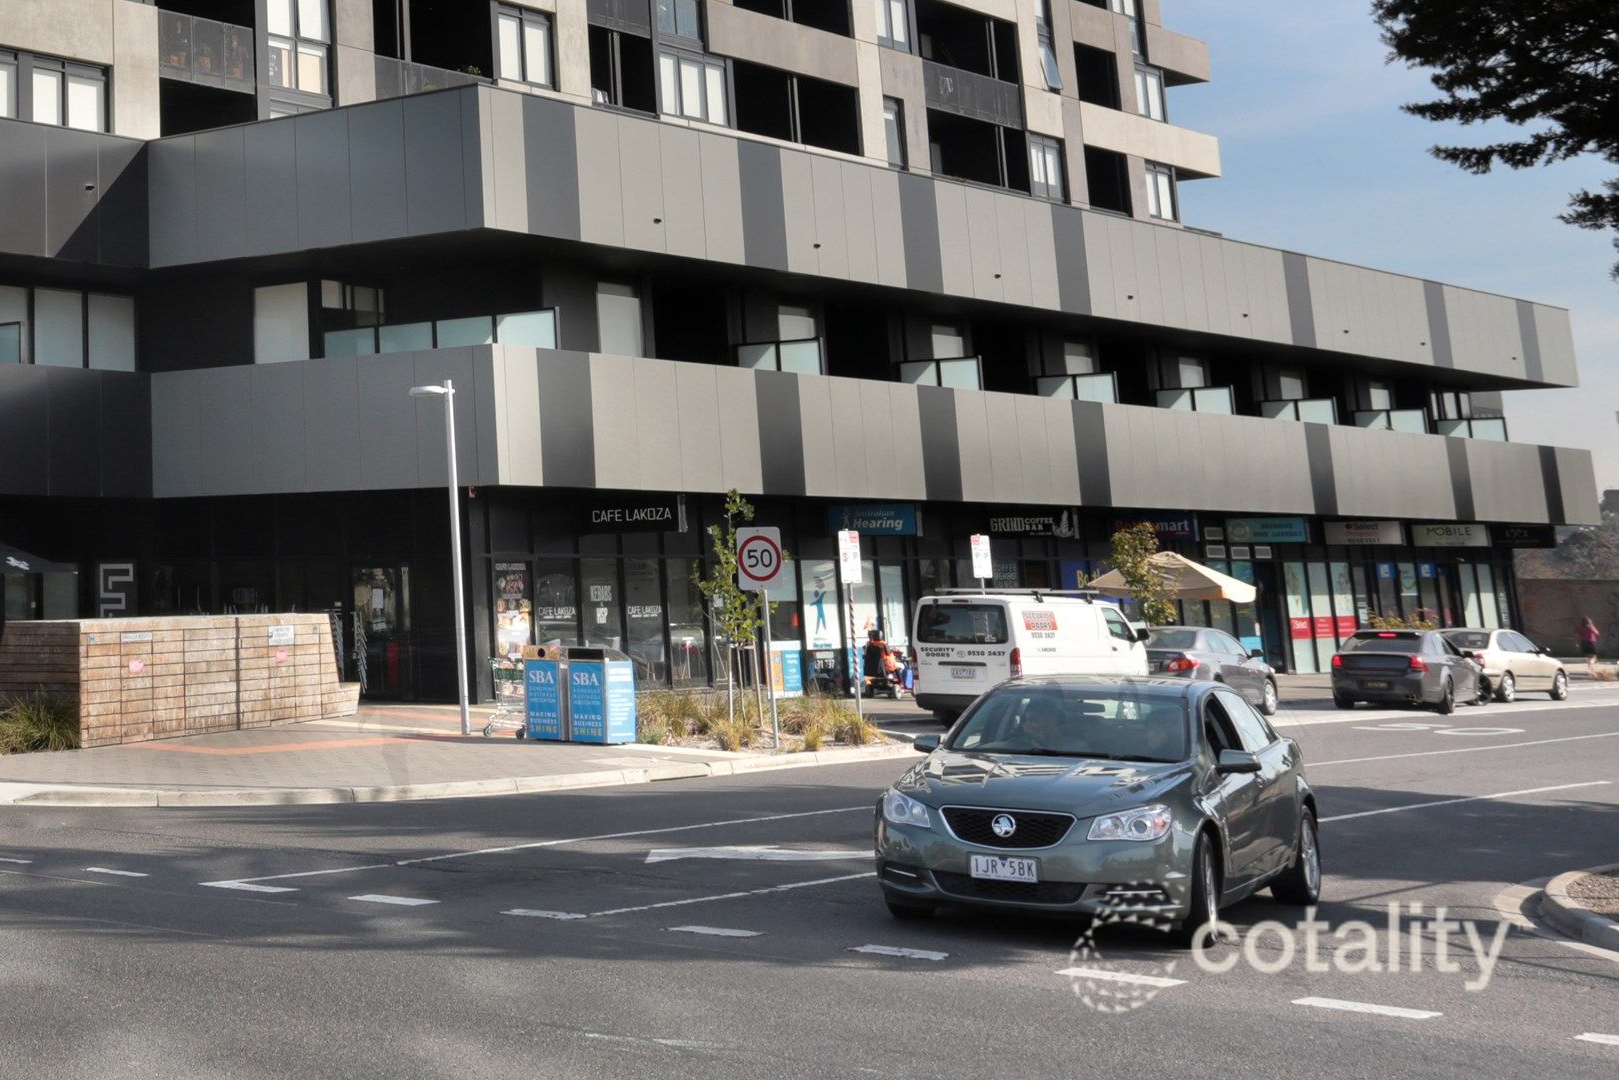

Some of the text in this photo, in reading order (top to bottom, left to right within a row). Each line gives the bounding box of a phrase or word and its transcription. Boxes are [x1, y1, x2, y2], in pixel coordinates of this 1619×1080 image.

[592, 507, 672, 523] CAFE LAKOZA
[852, 517, 904, 531] Hearing
[989, 517, 1025, 532] GRIND
[1426, 526, 1472, 537] MOBILE
[747, 548, 773, 568] 50
[590, 585, 613, 602] KEBABS
[538, 606, 577, 616] CAFE LAKOZA
[628, 606, 663, 615] CAFE LAKOZA
[528, 670, 555, 684] SBA
[572, 672, 600, 686] SBA
[530, 725, 558, 734] SHINE
[574, 727, 602, 737] SHINE
[974, 858, 999, 874] 1JR
[1009, 861, 1035, 878] 5BK
